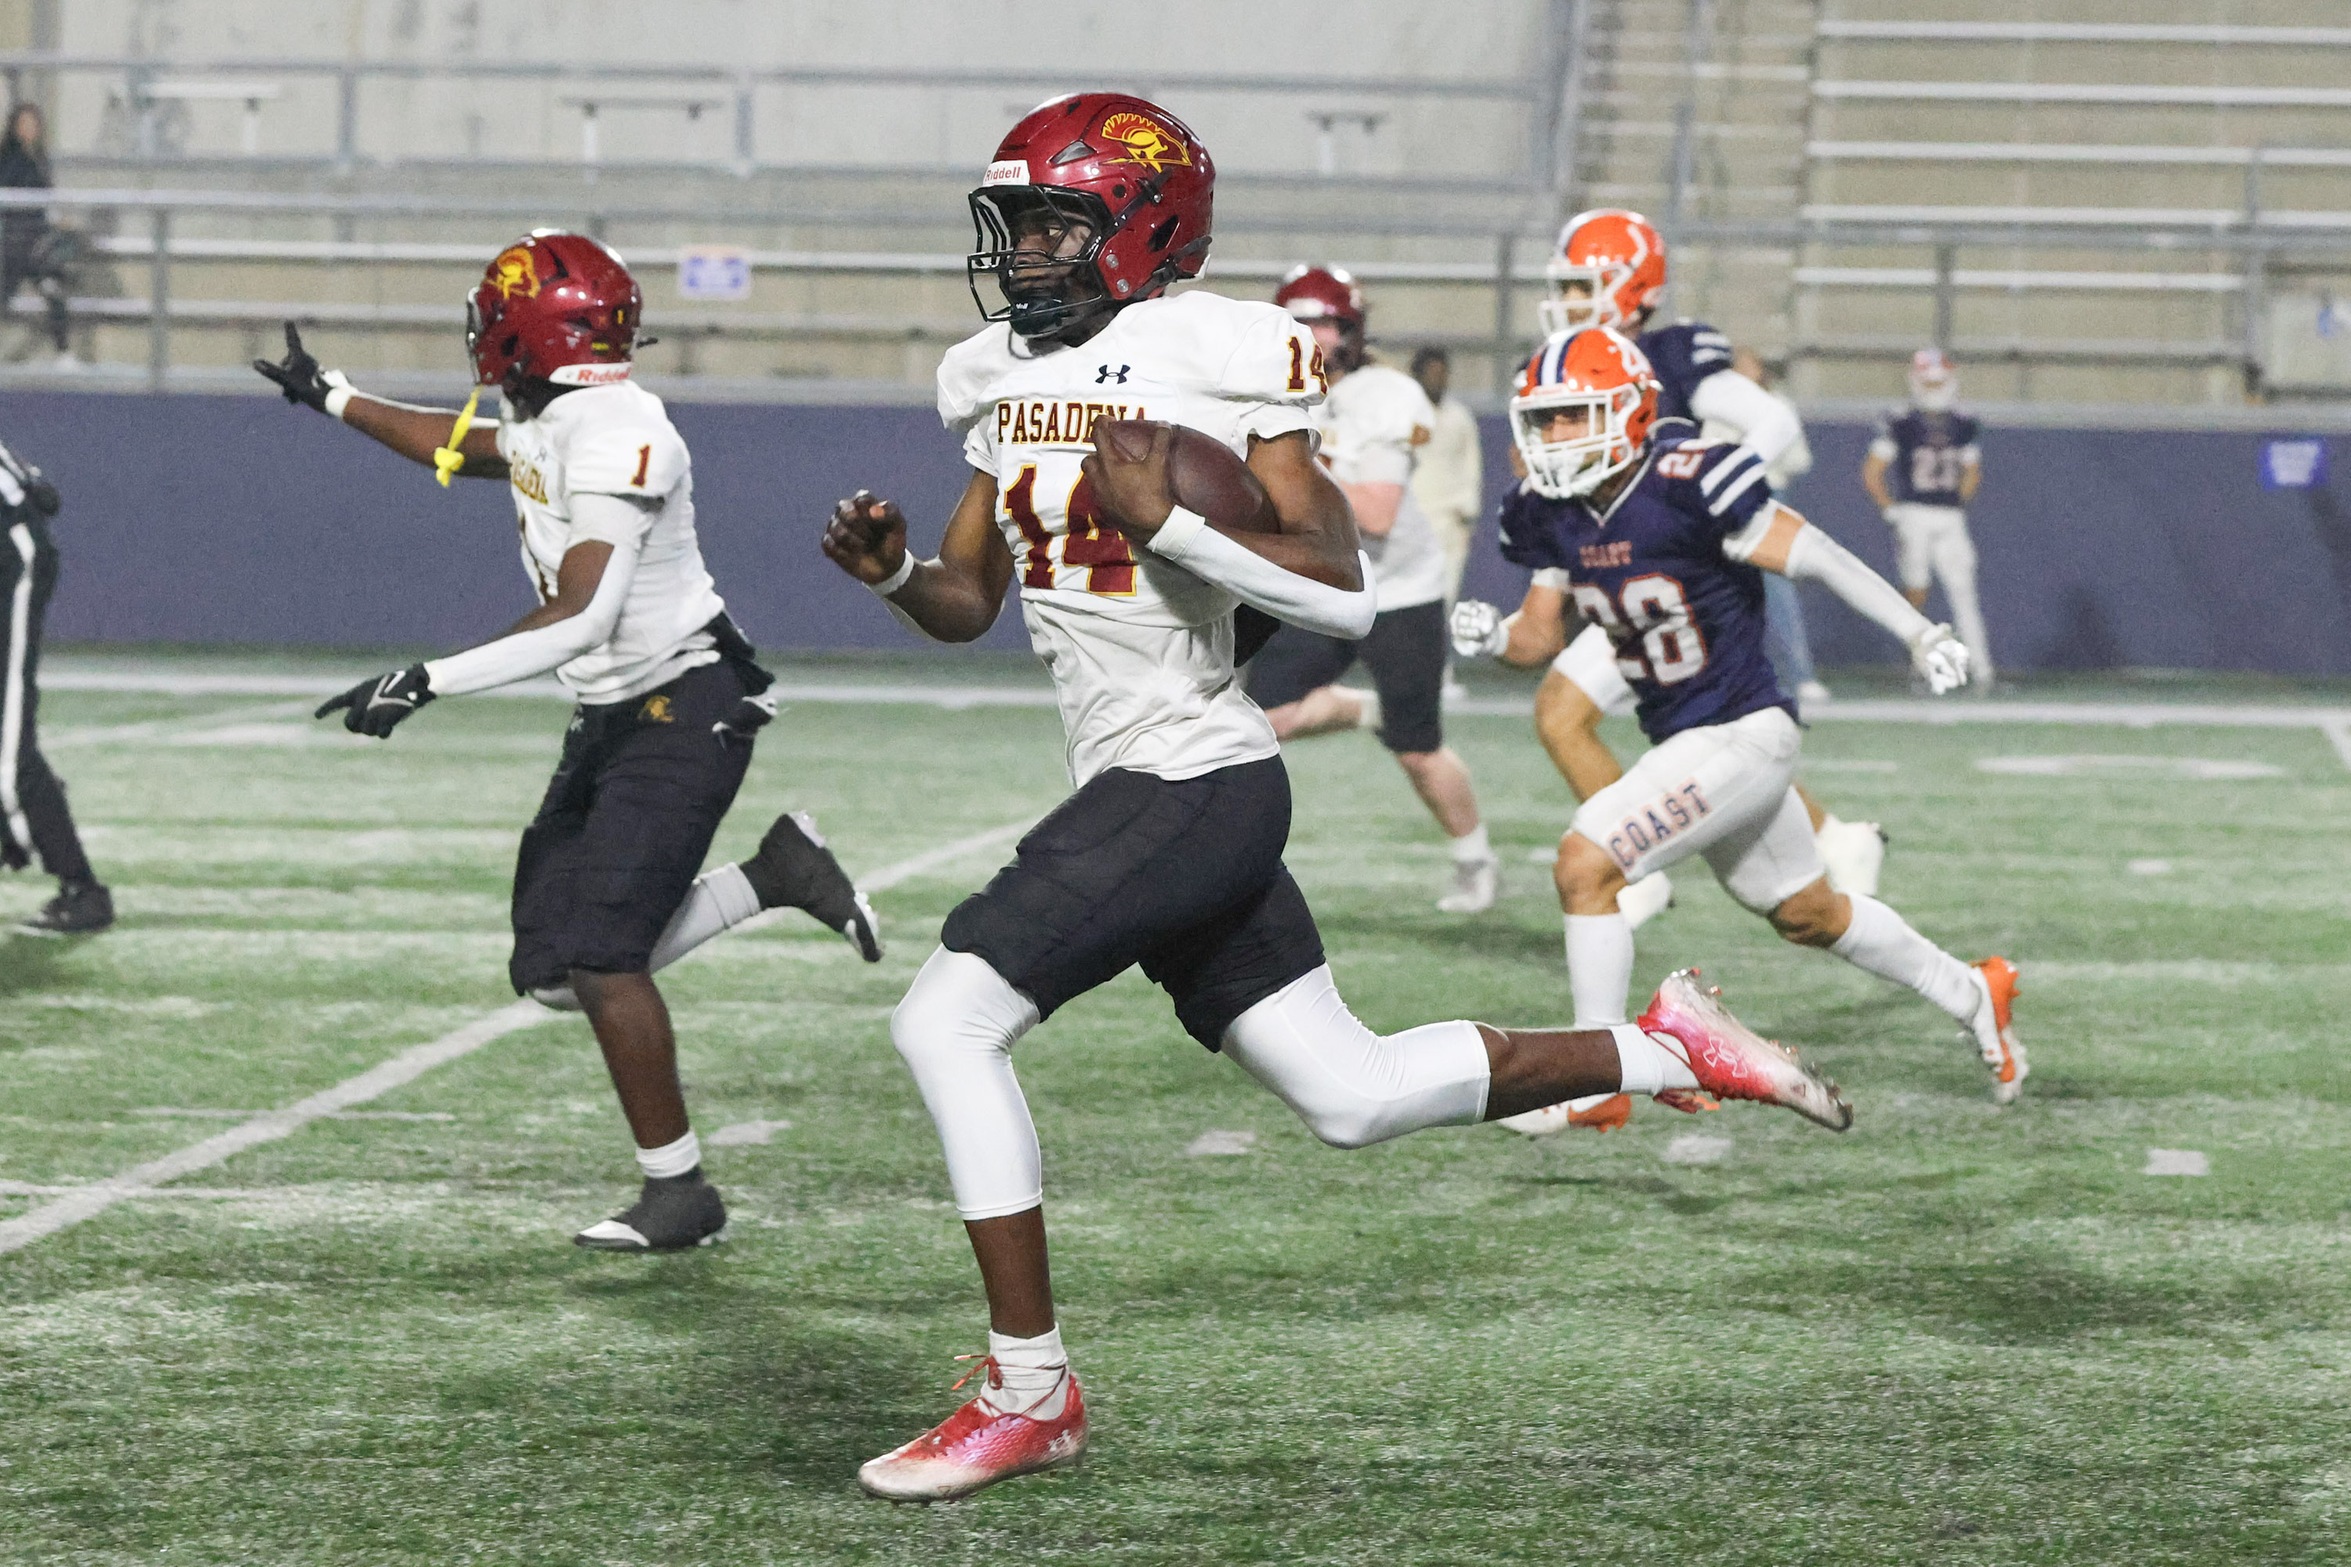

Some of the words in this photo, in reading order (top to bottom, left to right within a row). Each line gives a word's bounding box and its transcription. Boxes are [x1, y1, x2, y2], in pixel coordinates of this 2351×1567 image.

[985, 167, 1021, 182] Riddell
[1286, 335, 1330, 396] 14
[630, 443, 651, 489] 1
[1003, 464, 1137, 596] 14
[1608, 778, 1711, 871] COAST
